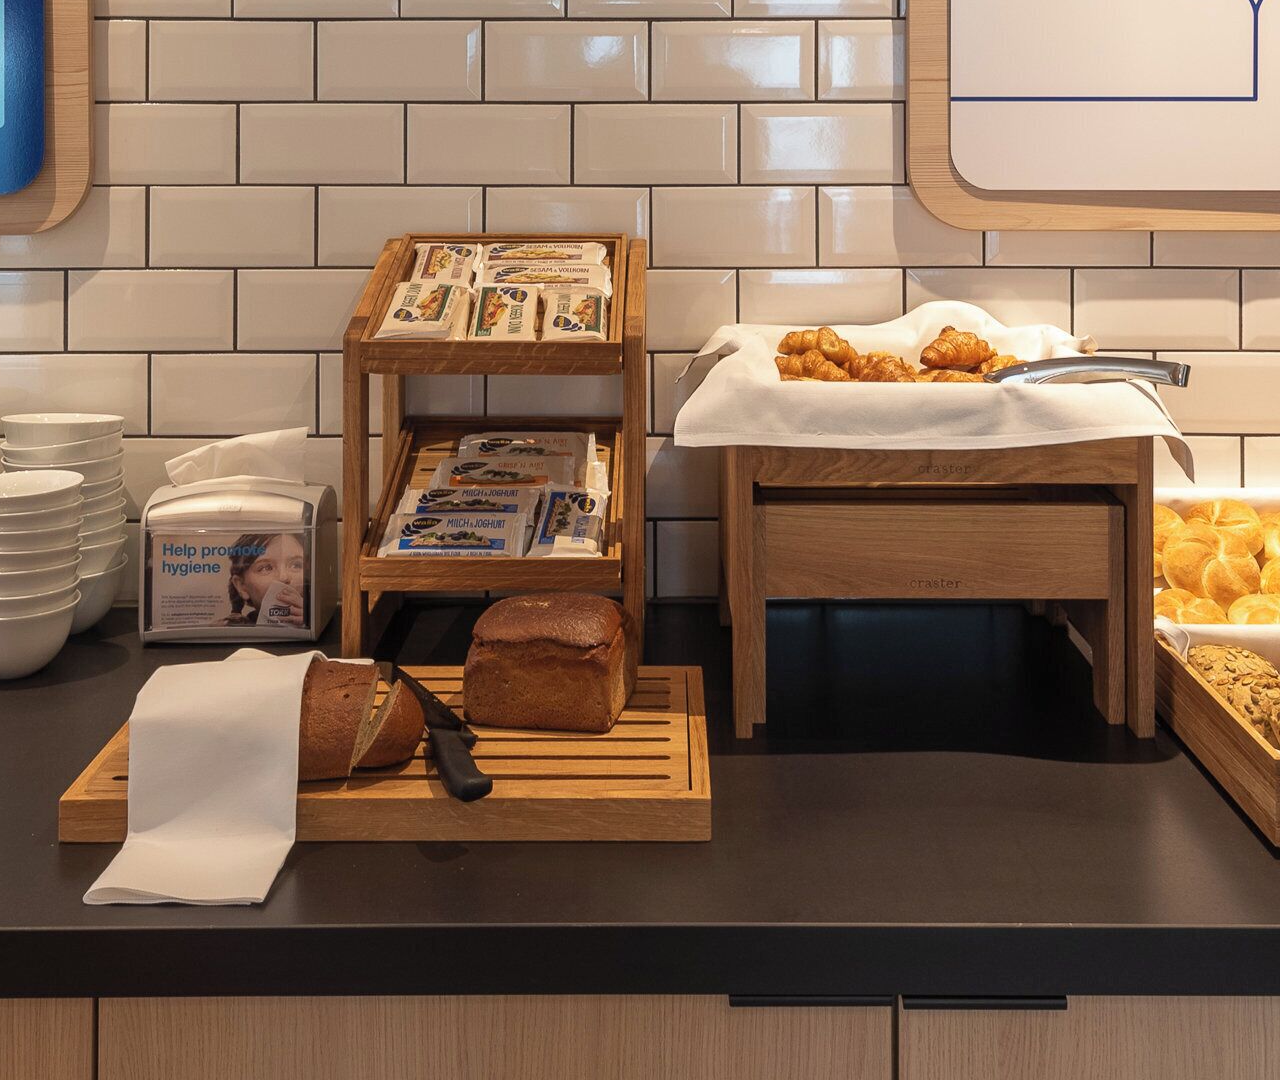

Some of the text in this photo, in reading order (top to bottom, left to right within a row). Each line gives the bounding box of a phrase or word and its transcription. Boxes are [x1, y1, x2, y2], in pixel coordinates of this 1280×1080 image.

[461, 488, 485, 497] MILCH
[488, 489, 519, 497] JOGHURT
[447, 519, 469, 528] MILCH
[474, 519, 506, 529] JOGHURT
[162, 543, 267, 560] Help promote
[162, 560, 221, 576] hygiene
